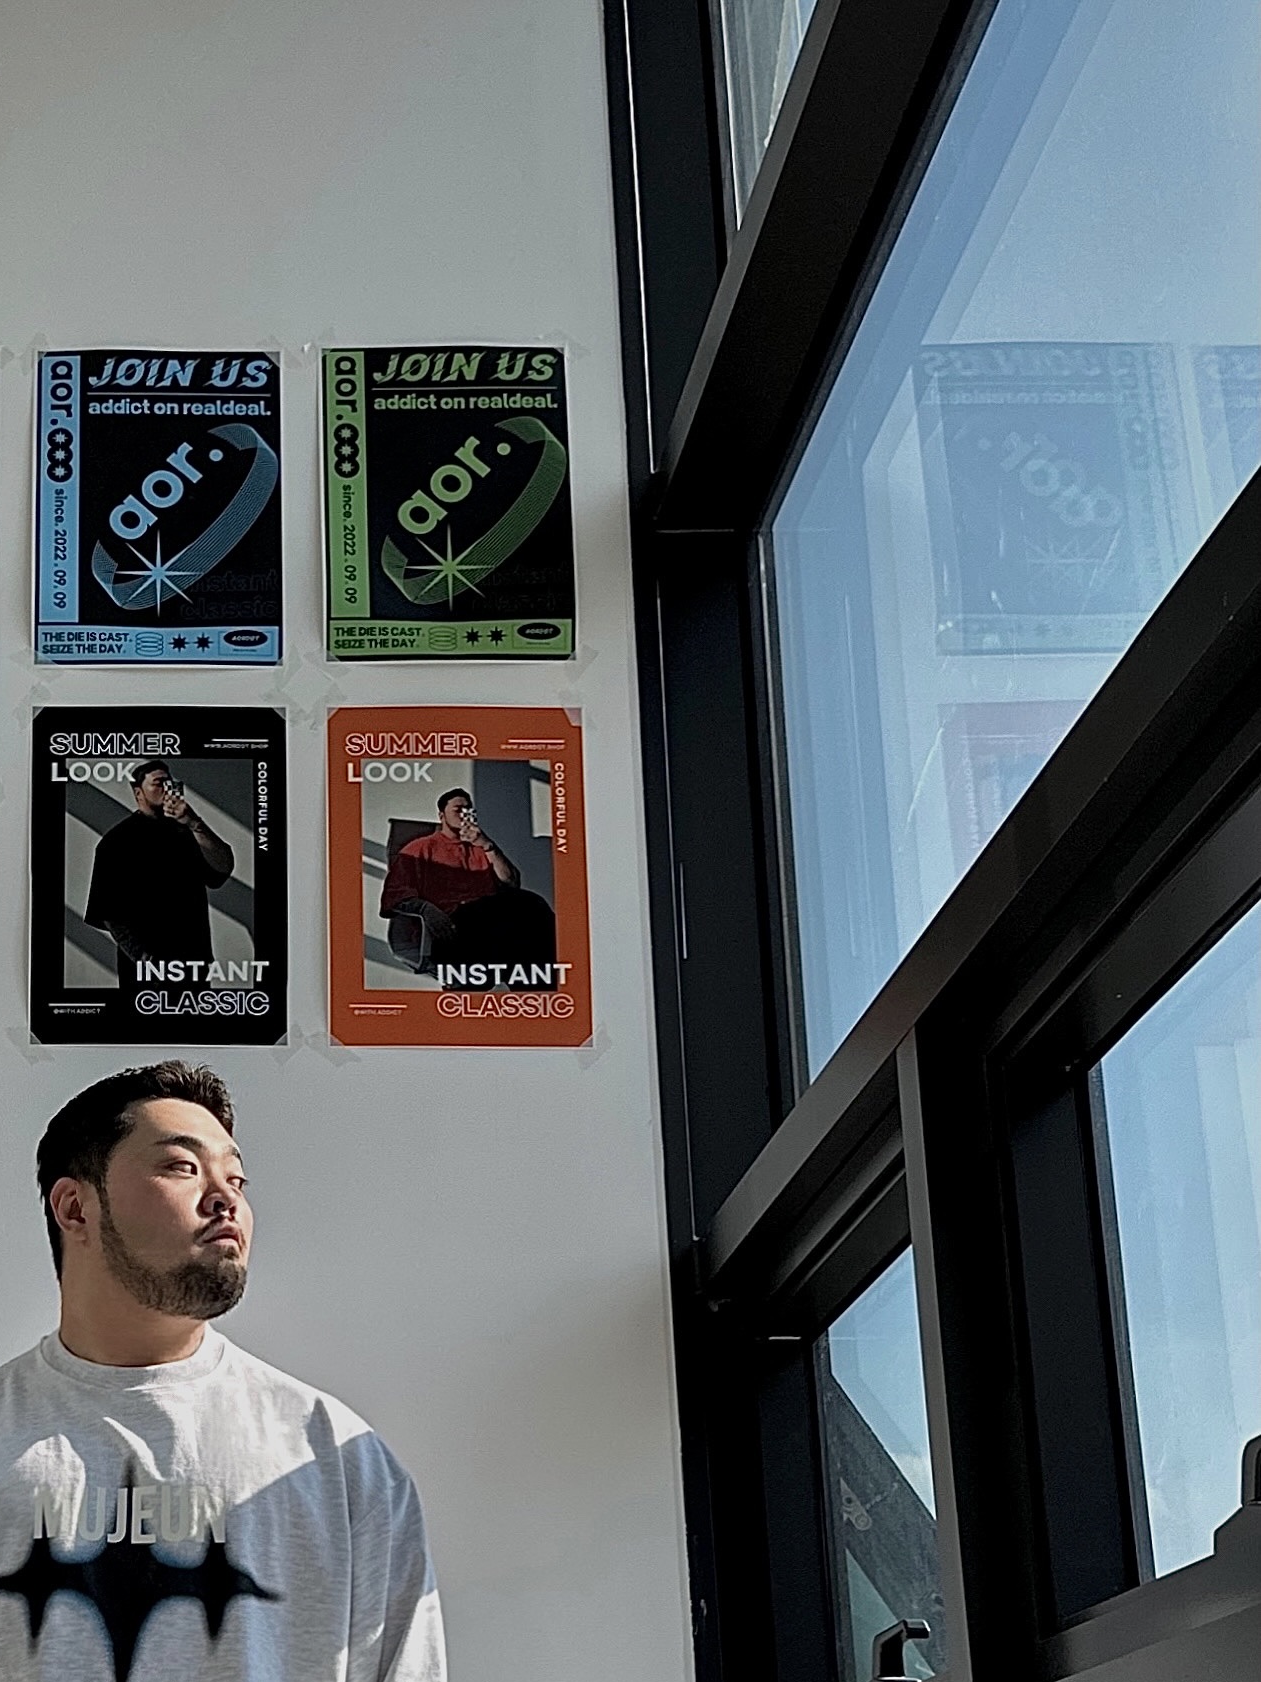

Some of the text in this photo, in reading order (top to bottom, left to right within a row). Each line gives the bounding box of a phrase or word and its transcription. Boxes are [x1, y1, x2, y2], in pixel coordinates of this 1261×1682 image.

[88, 357, 273, 388] JOIN US
[373, 351, 558, 384] JOIN US
[50, 361, 74, 426] aor.
[334, 356, 358, 420] aor.
[88, 398, 271, 416] addict on realdeal.
[374, 393, 558, 410] addict on realdeal.
[109, 442, 223, 539] aor.
[397, 436, 511, 534] aor.
[42, 632, 132, 642] THE DIE IS CAST.
[334, 627, 356, 637] THE
[358, 627, 377, 637] DIE
[378, 627, 389, 637] IS
[42, 644, 126, 654] SEIZE THE DAY.
[334, 639, 365, 649] SEIZE
[367, 639, 389, 648] THE
[50, 733, 181, 755] SUMMER
[345, 733, 478, 756] SUMMER
[51, 761, 137, 783] LOOK
[347, 761, 433, 783] LOOK
[258, 762, 269, 851] COLORFUL DAY
[554, 762, 568, 853] COLORFUL DAY
[136, 961, 269, 982] INSTANT
[437, 963, 572, 985] INSTANT
[135, 990, 269, 1015] CLASSIC
[437, 993, 574, 1018] CLASSIC
[33, 1484, 226, 1544] MUJEUN
